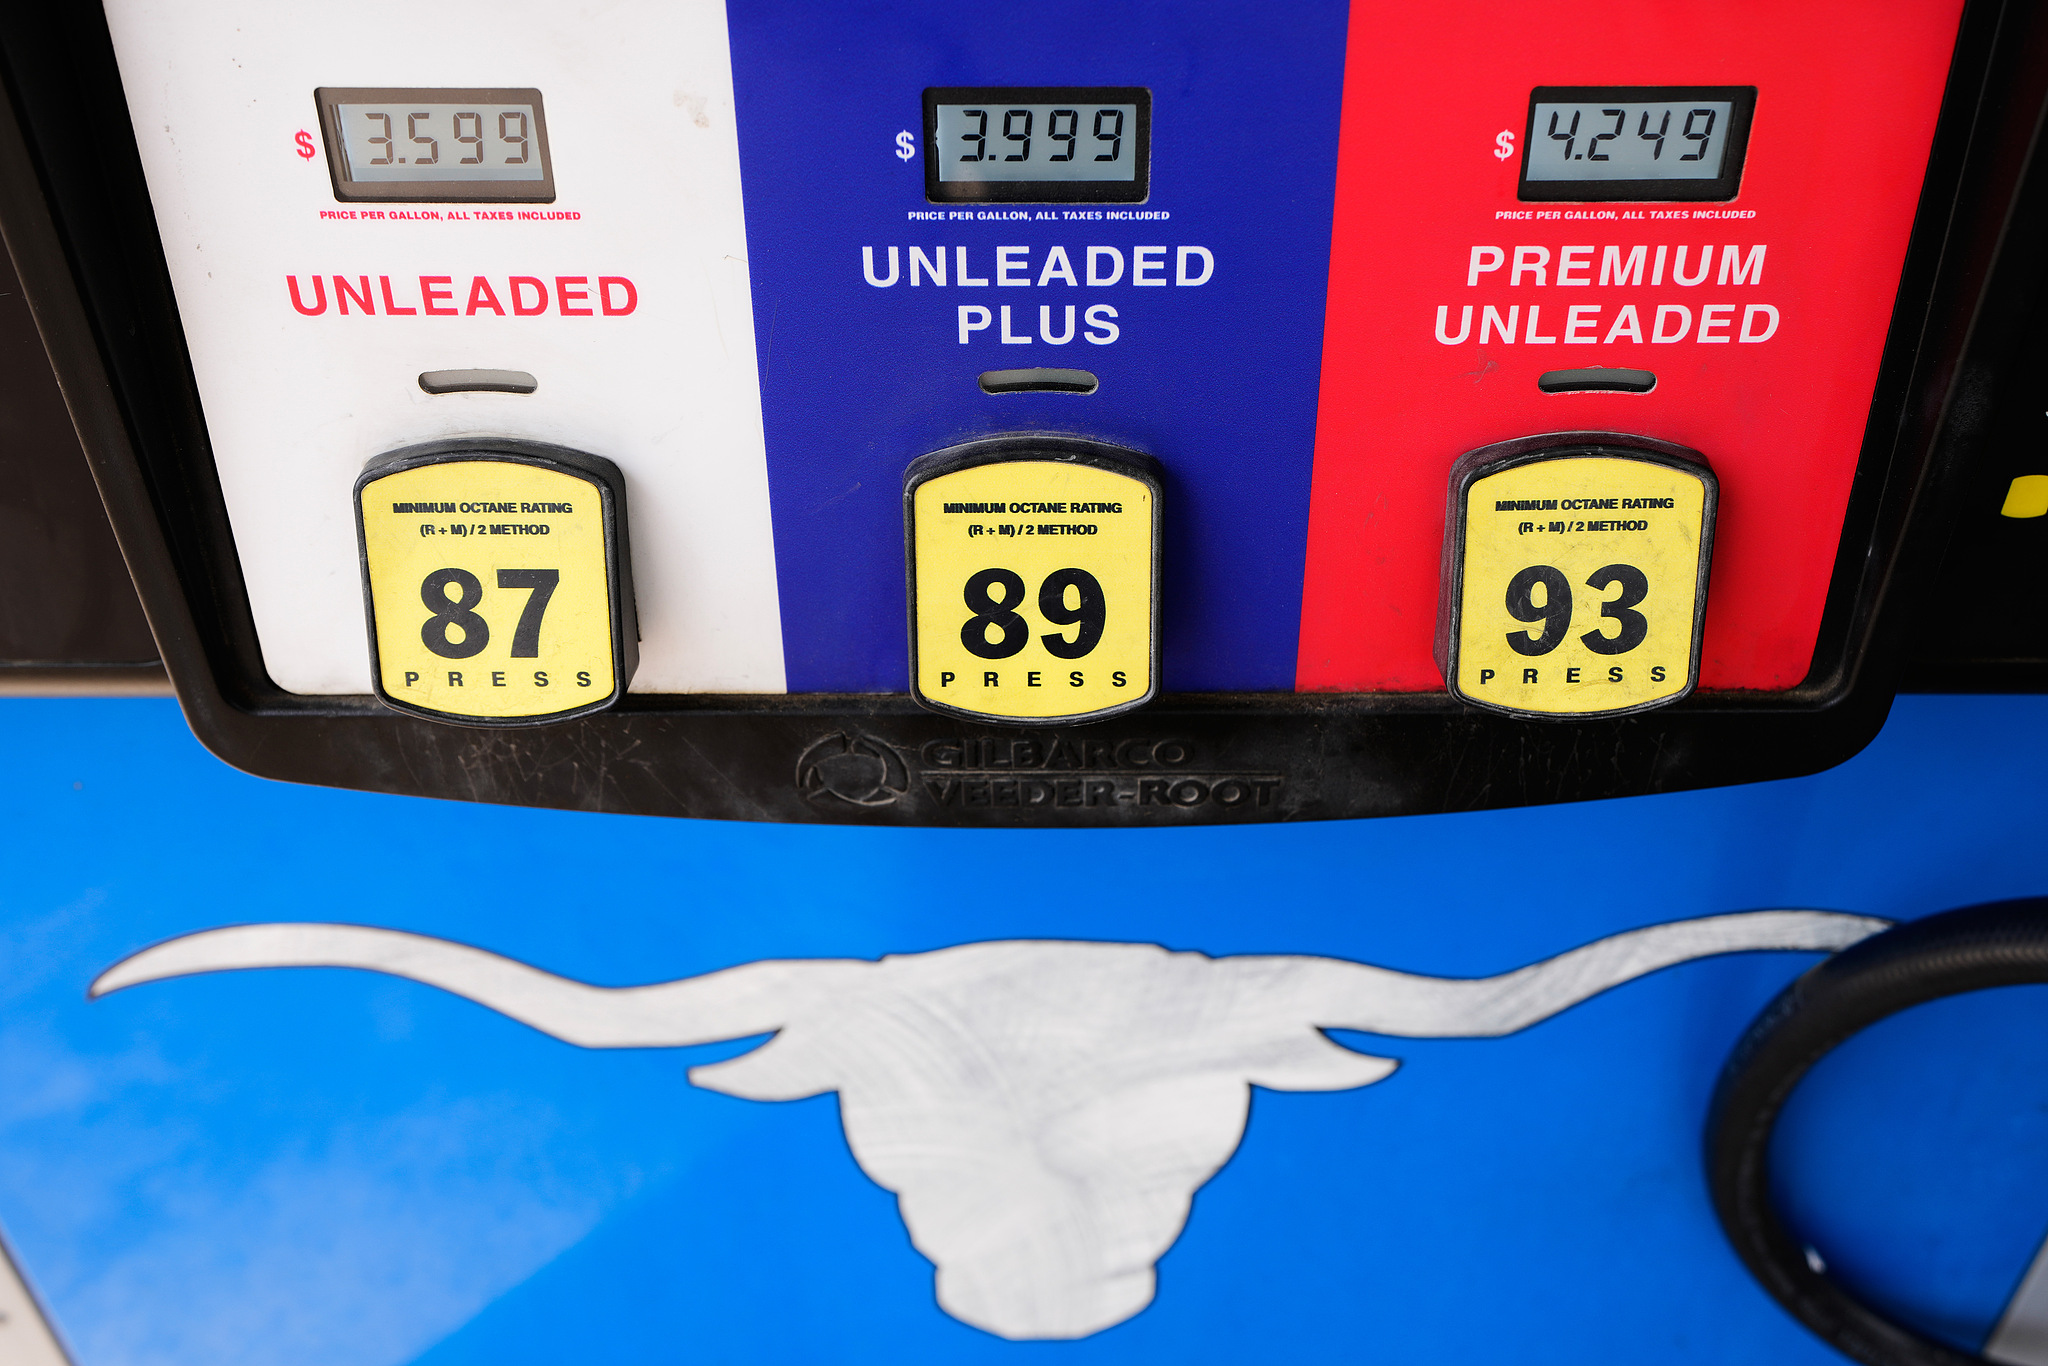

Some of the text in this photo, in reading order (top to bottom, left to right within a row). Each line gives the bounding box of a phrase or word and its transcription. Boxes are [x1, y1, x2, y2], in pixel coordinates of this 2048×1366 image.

[294, 112, 528, 164] $ 3.599
[895, 109, 1124, 162] $ 3.999
[1494, 109, 1716, 161] $ 4.249
[320, 211, 581, 221] PRICE PER GALLON, ALL TAXES INCLUDED
[908, 211, 1170, 221] PRICE PER GALLON, ALL TAXES INCLUDED
[1495, 210, 1756, 220] PRICE PER GALLON, ALL TAXES INCLUDED
[862, 246, 1214, 287] UNLEADED
[1467, 244, 1767, 286] PREMIUM
[286, 275, 638, 316] UNLEADED
[958, 304, 1120, 345] PLUS
[1434, 304, 1780, 345] UNLEADED
[393, 503, 572, 513] MINIMUM OCTANE RATING
[944, 503, 1122, 513] MINIMUM OCTANE RATING
[1495, 498, 1674, 511] MINIMUM OCTANE RATING
[420, 524, 549, 537] (R + M) / 2 METHOD
[968, 524, 1097, 537] (R + M) / 2 METHOD
[1518, 521, 1648, 535] (R + M) / 2 METHOD
[420, 568, 559, 659] 87
[961, 568, 1106, 659] 89
[1505, 564, 1648, 656] 93
[405, 672, 592, 687] PRESS
[941, 671, 1127, 687] PRESS
[1480, 666, 1666, 684] PRESS
[920, 738, 1195, 770] GILBARCO
[922, 777, 1284, 808] VEEDER-ROOT
